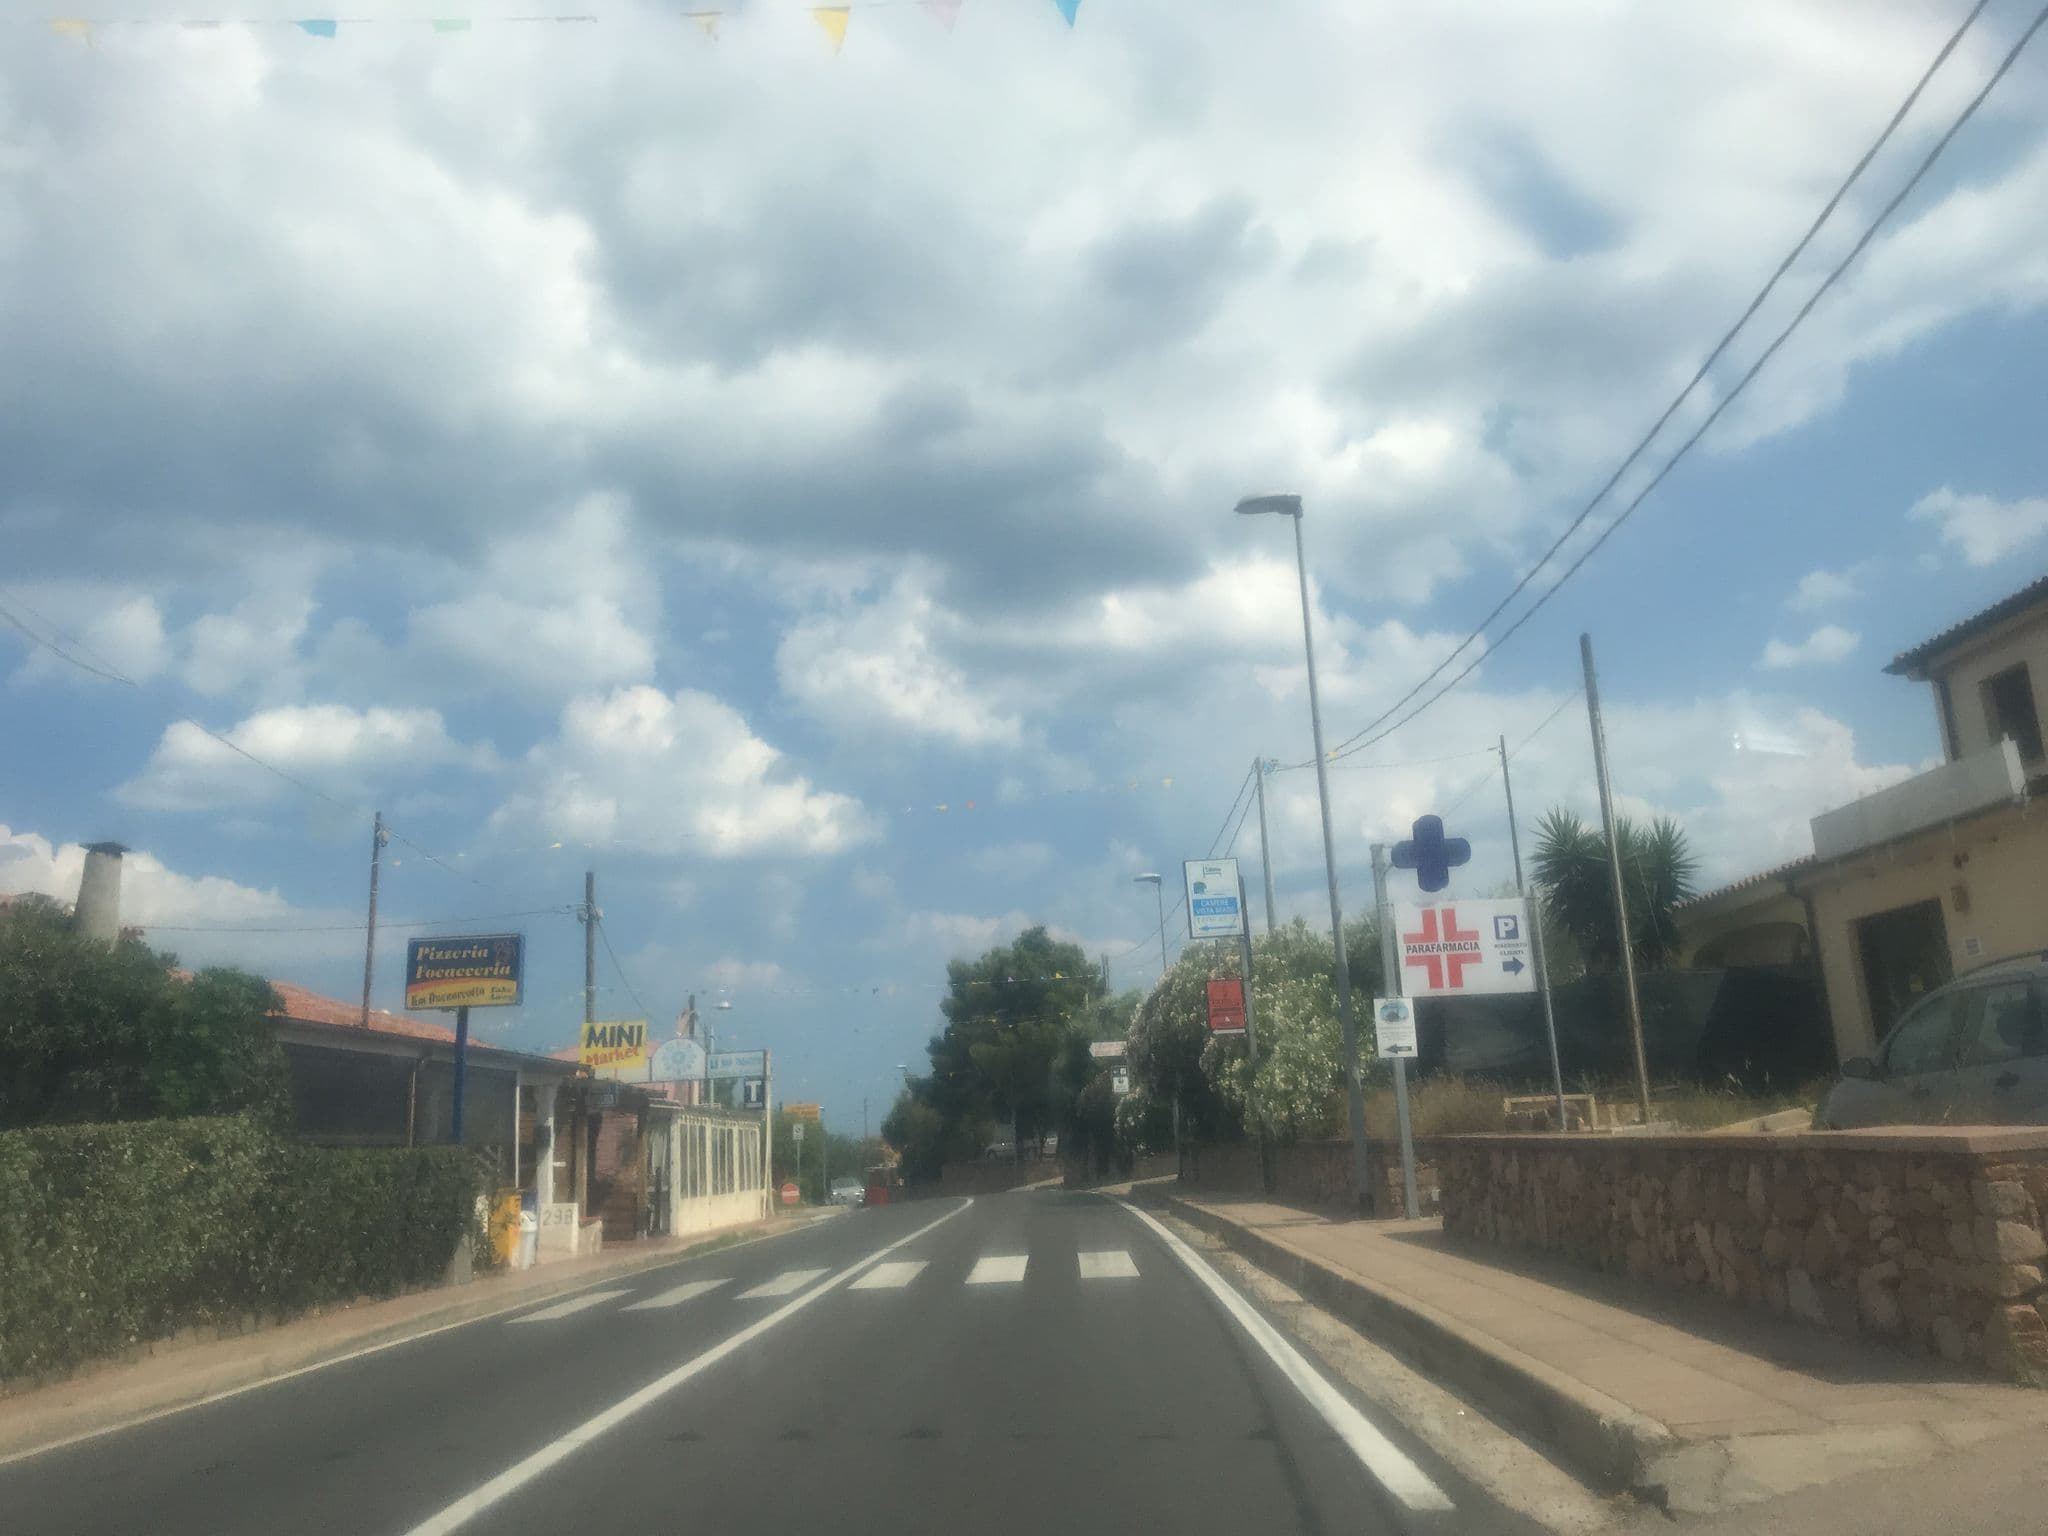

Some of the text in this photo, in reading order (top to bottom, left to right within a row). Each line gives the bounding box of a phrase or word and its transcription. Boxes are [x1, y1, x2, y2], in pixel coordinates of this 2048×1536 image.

[1498, 918, 1515, 938] P
[417, 945, 488, 960] Pizzeria
[1407, 941, 1480, 954] PARAFARMACIA
[586, 1024, 643, 1048] MINI
[586, 1046, 639, 1065] Market
[745, 1080, 761, 1102] T
